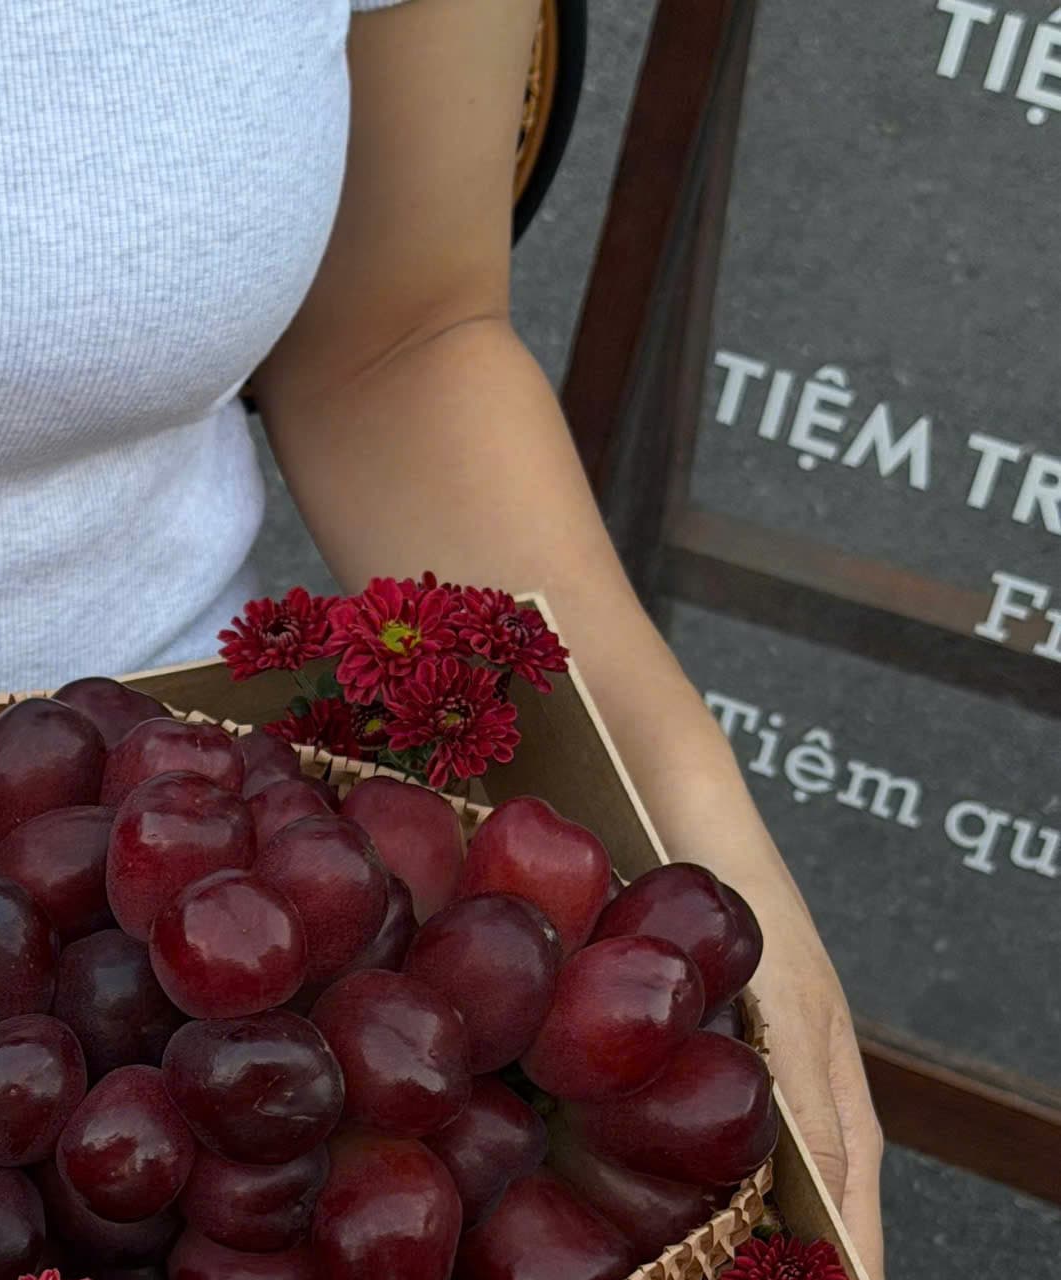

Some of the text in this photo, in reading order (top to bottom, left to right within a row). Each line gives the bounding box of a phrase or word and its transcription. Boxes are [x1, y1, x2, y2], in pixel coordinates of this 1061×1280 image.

[714, 350, 1061, 536] TIỆM TR
[705, 692, 1059, 878] Tiệm qu
